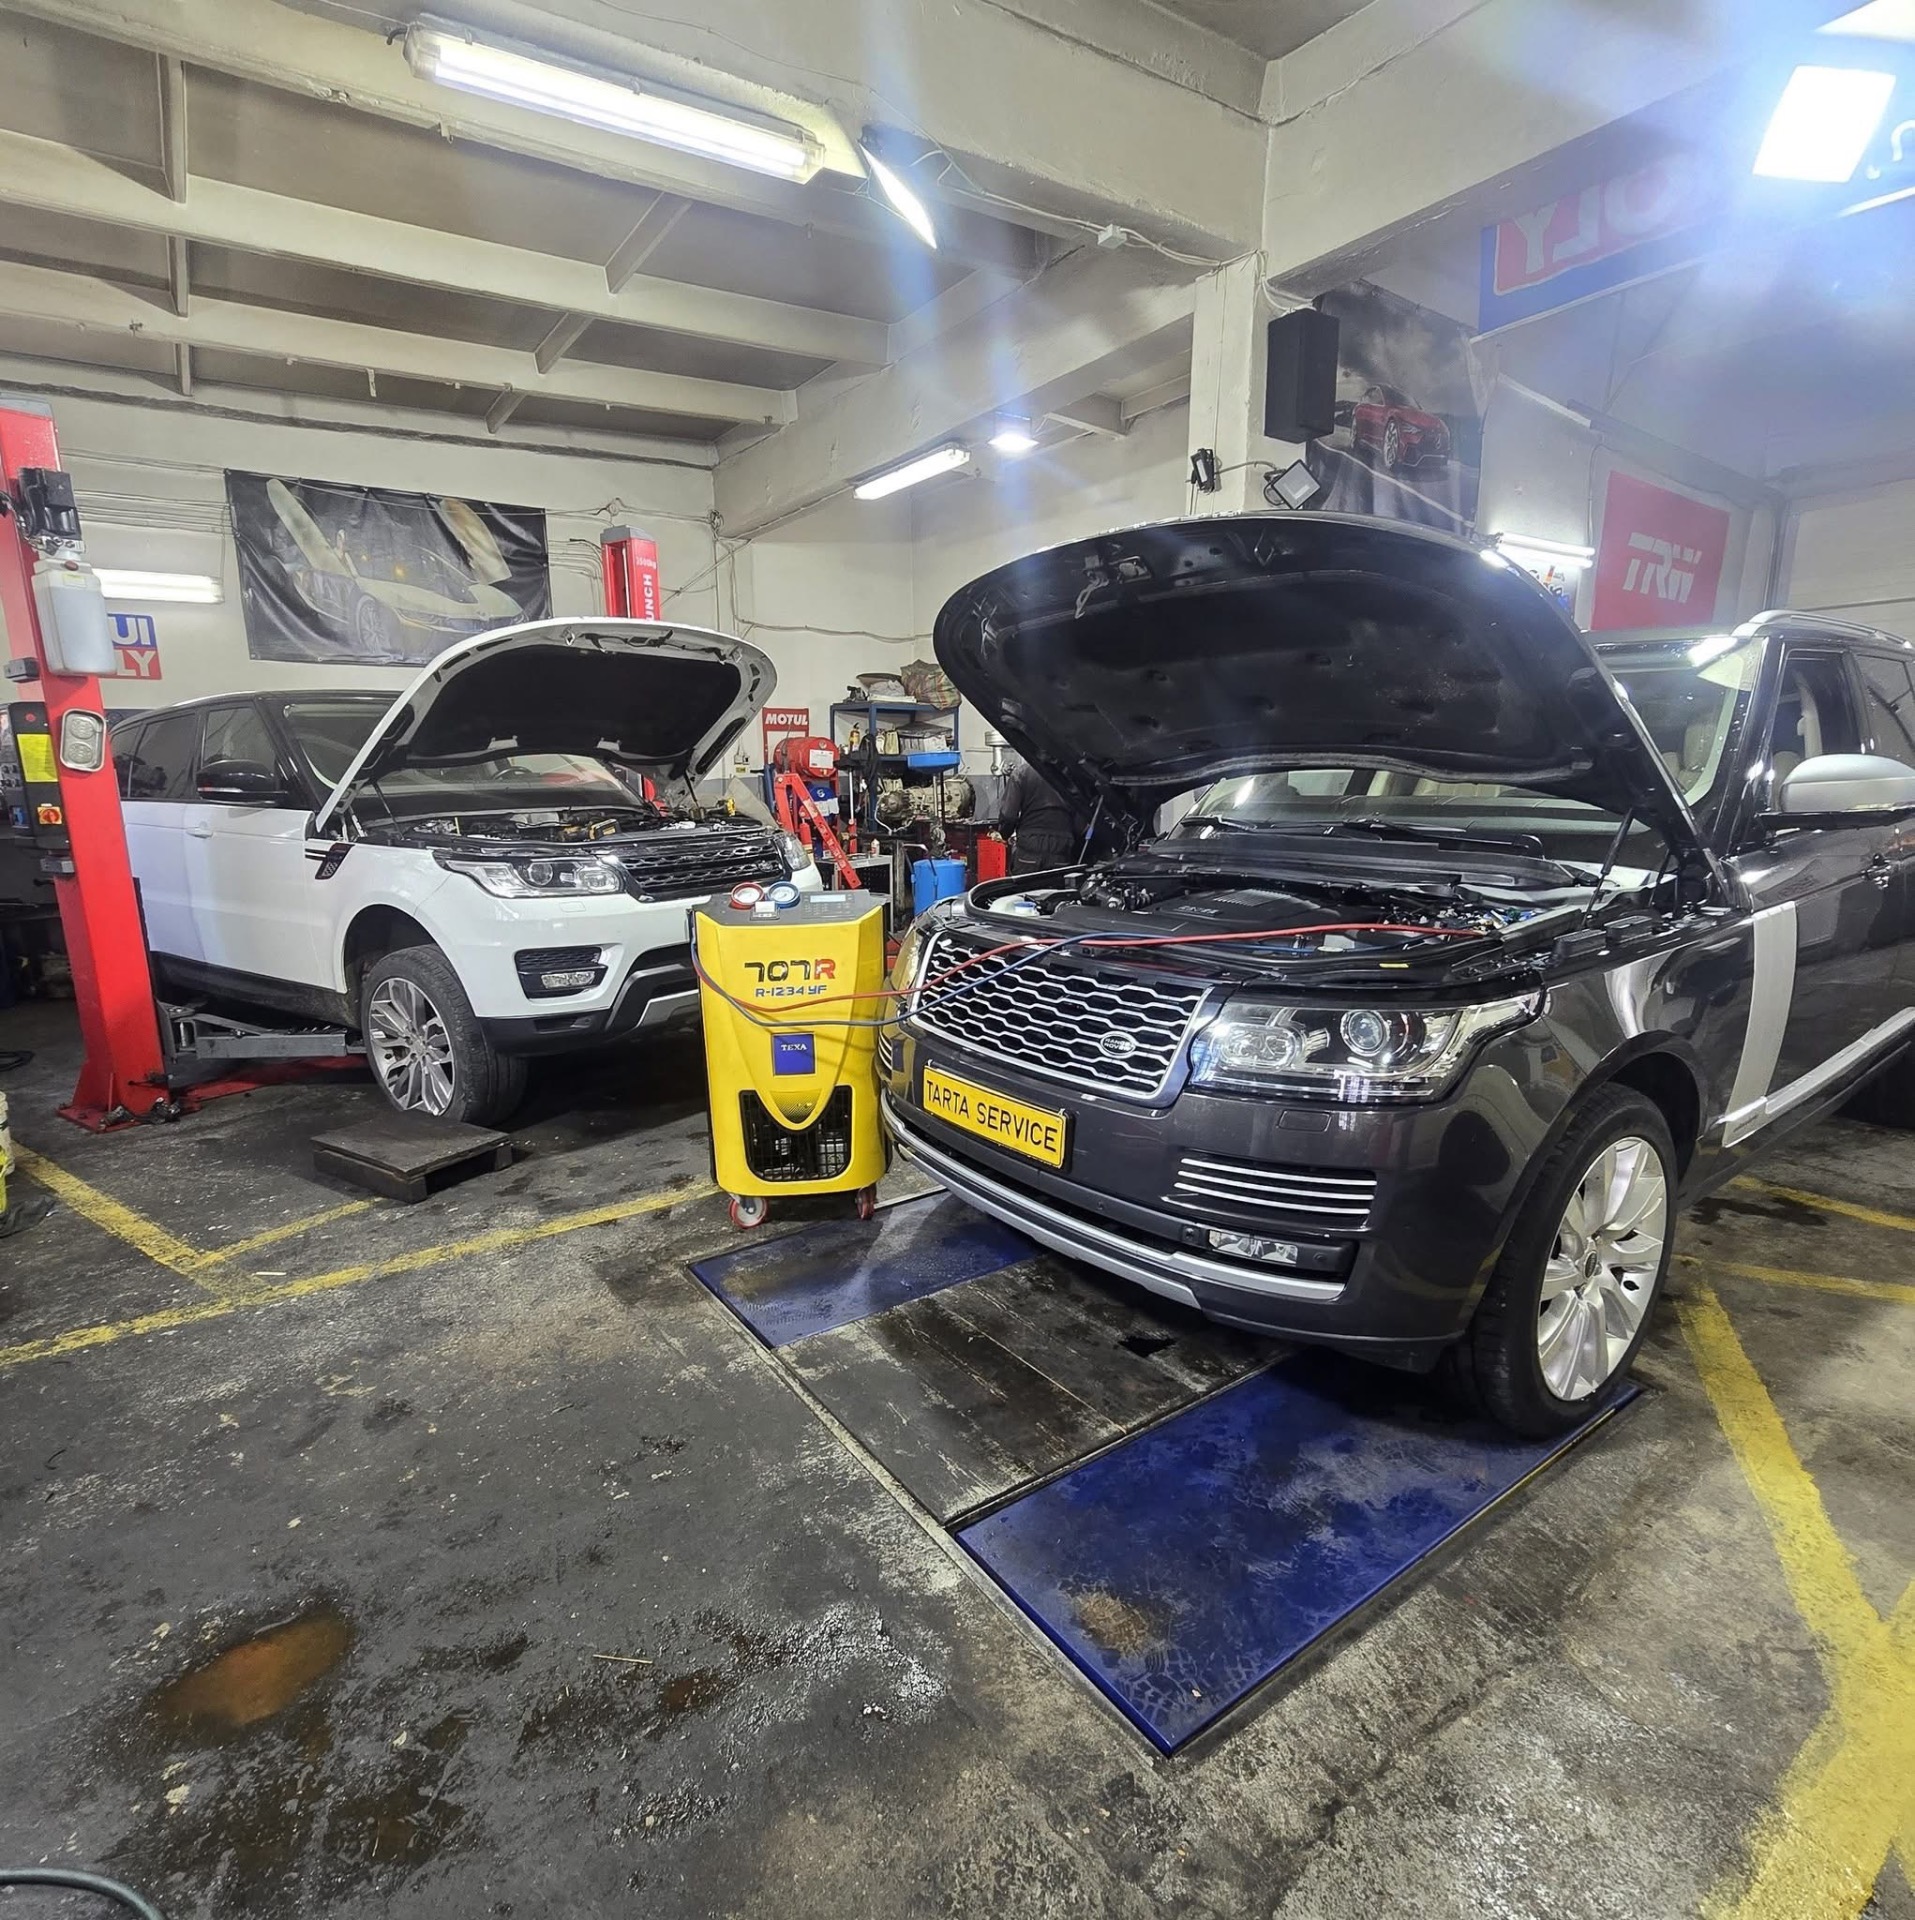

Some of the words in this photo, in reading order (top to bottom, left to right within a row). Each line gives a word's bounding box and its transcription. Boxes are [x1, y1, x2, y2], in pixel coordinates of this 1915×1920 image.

[1622, 531, 1702, 604] TRW
[642, 573, 655, 621] UNCH
[107, 616, 151, 645] UI
[114, 649, 157, 676] LY
[765, 713, 808, 726] MOTUL
[744, 959, 836, 982] 707R
[781, 1043, 807, 1051] TEXA
[926, 1080, 970, 1119] TARTA
[976, 1102, 1058, 1153] SERVICE
